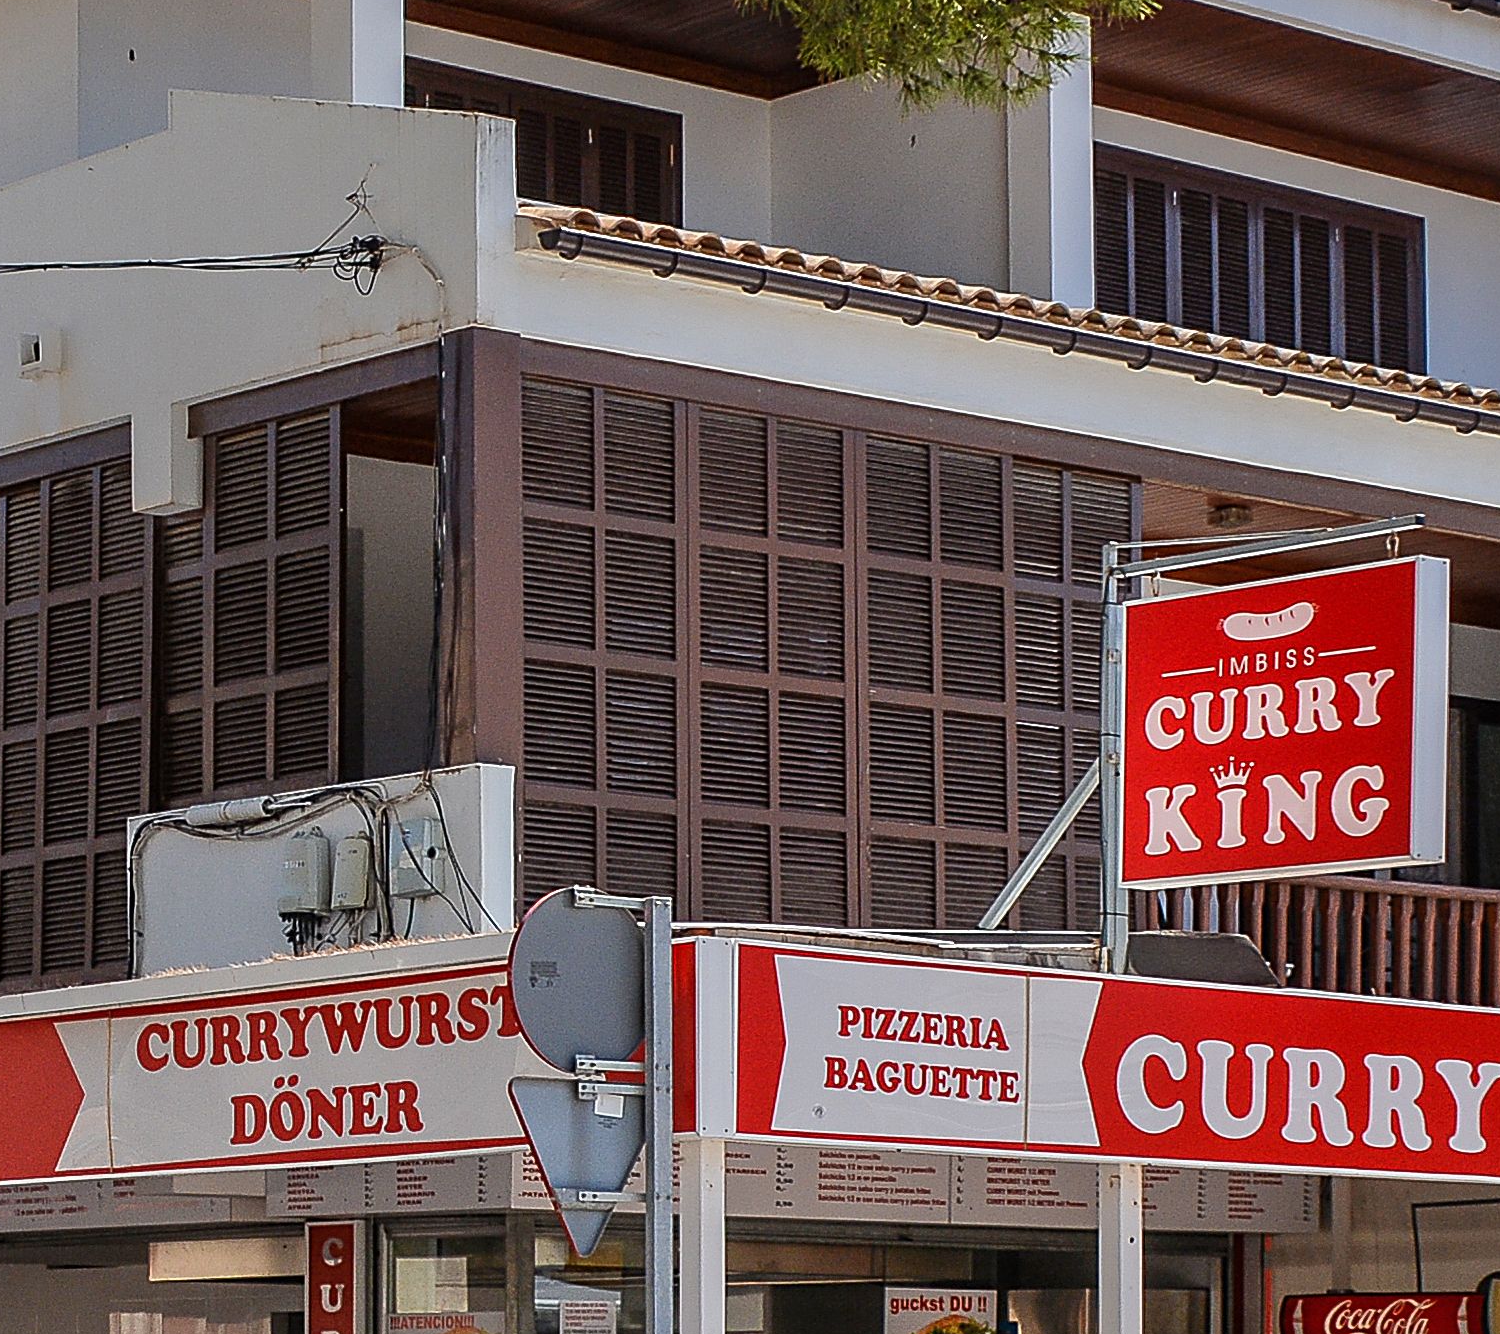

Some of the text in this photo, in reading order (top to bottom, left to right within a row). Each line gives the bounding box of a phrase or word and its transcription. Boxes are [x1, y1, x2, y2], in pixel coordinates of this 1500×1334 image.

[1217, 646, 1316, 677] IMBISS
[1144, 668, 1396, 751] CURRY
[1144, 759, 1390, 856] KING
[136, 985, 521, 1073] CURRYWURST
[837, 1004, 1010, 1051] PIZZERIA
[823, 1055, 1021, 1104] BAGUETTE
[229, 1075, 425, 1146] DÖNER
[890, 1295, 987, 1315] guckst DU !!
